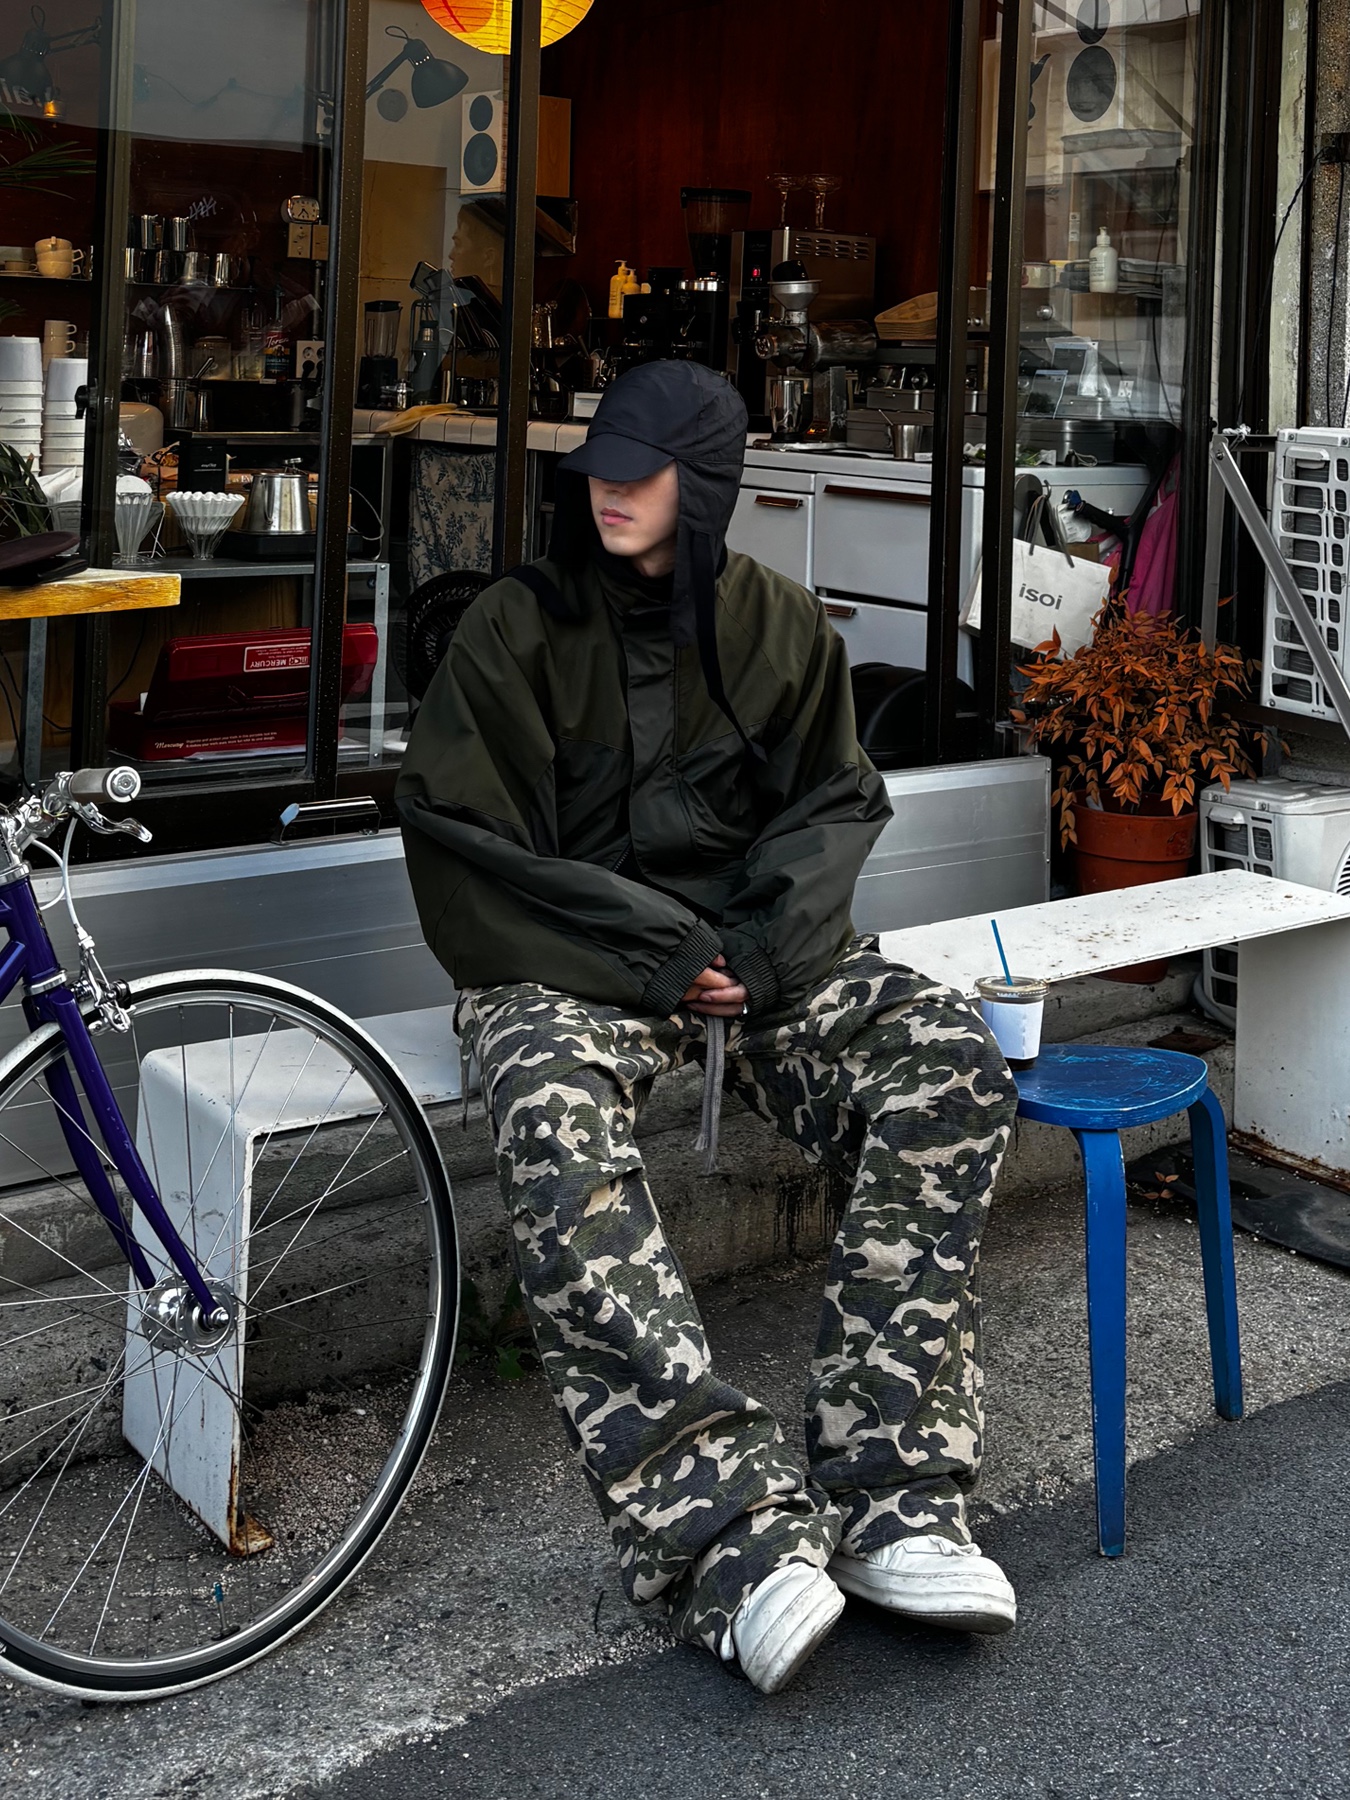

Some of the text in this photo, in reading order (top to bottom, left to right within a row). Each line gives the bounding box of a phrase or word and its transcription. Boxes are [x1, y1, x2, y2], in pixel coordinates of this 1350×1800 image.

[1019, 583, 1063, 610] isoi
[250, 659, 287, 668] MERCURY
[155, 741, 184, 750] Mercury
